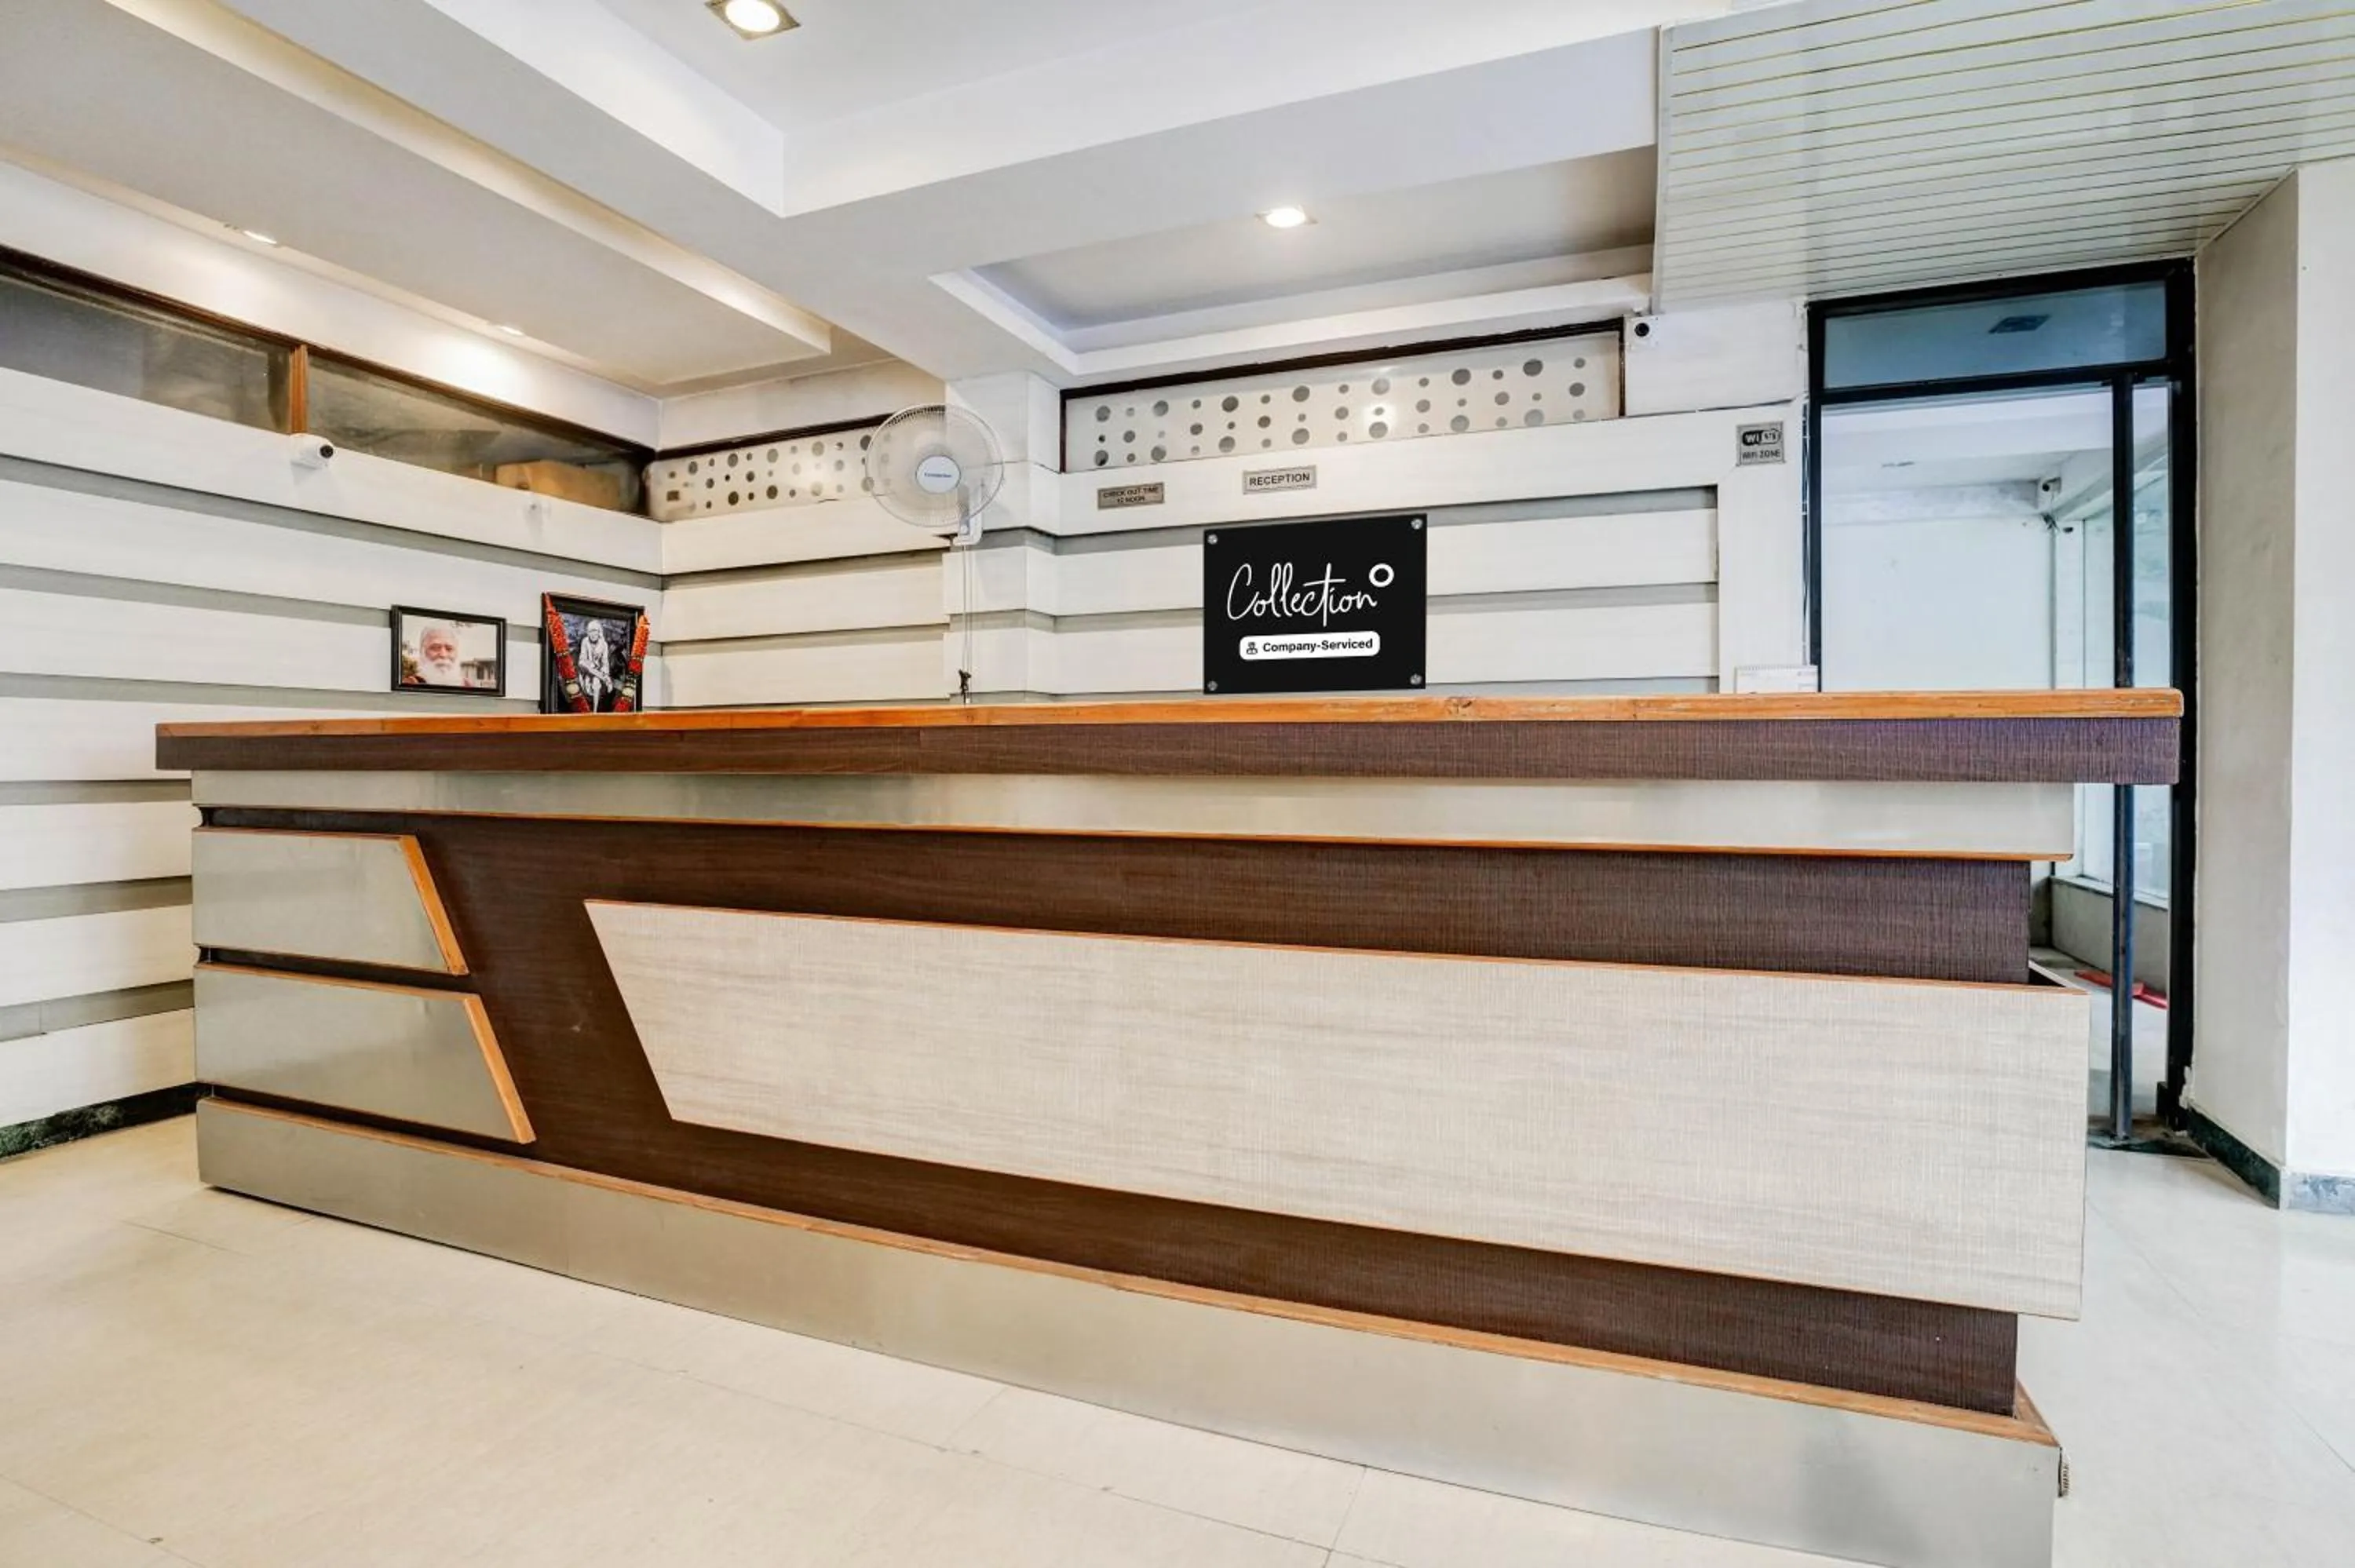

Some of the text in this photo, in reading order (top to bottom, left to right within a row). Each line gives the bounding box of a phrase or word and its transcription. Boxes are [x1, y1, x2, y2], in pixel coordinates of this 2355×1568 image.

[1249, 472, 1310, 486] RECEPTION
[1227, 562, 1378, 627] Collection
[1262, 638, 1373, 654] Company-Serviced
